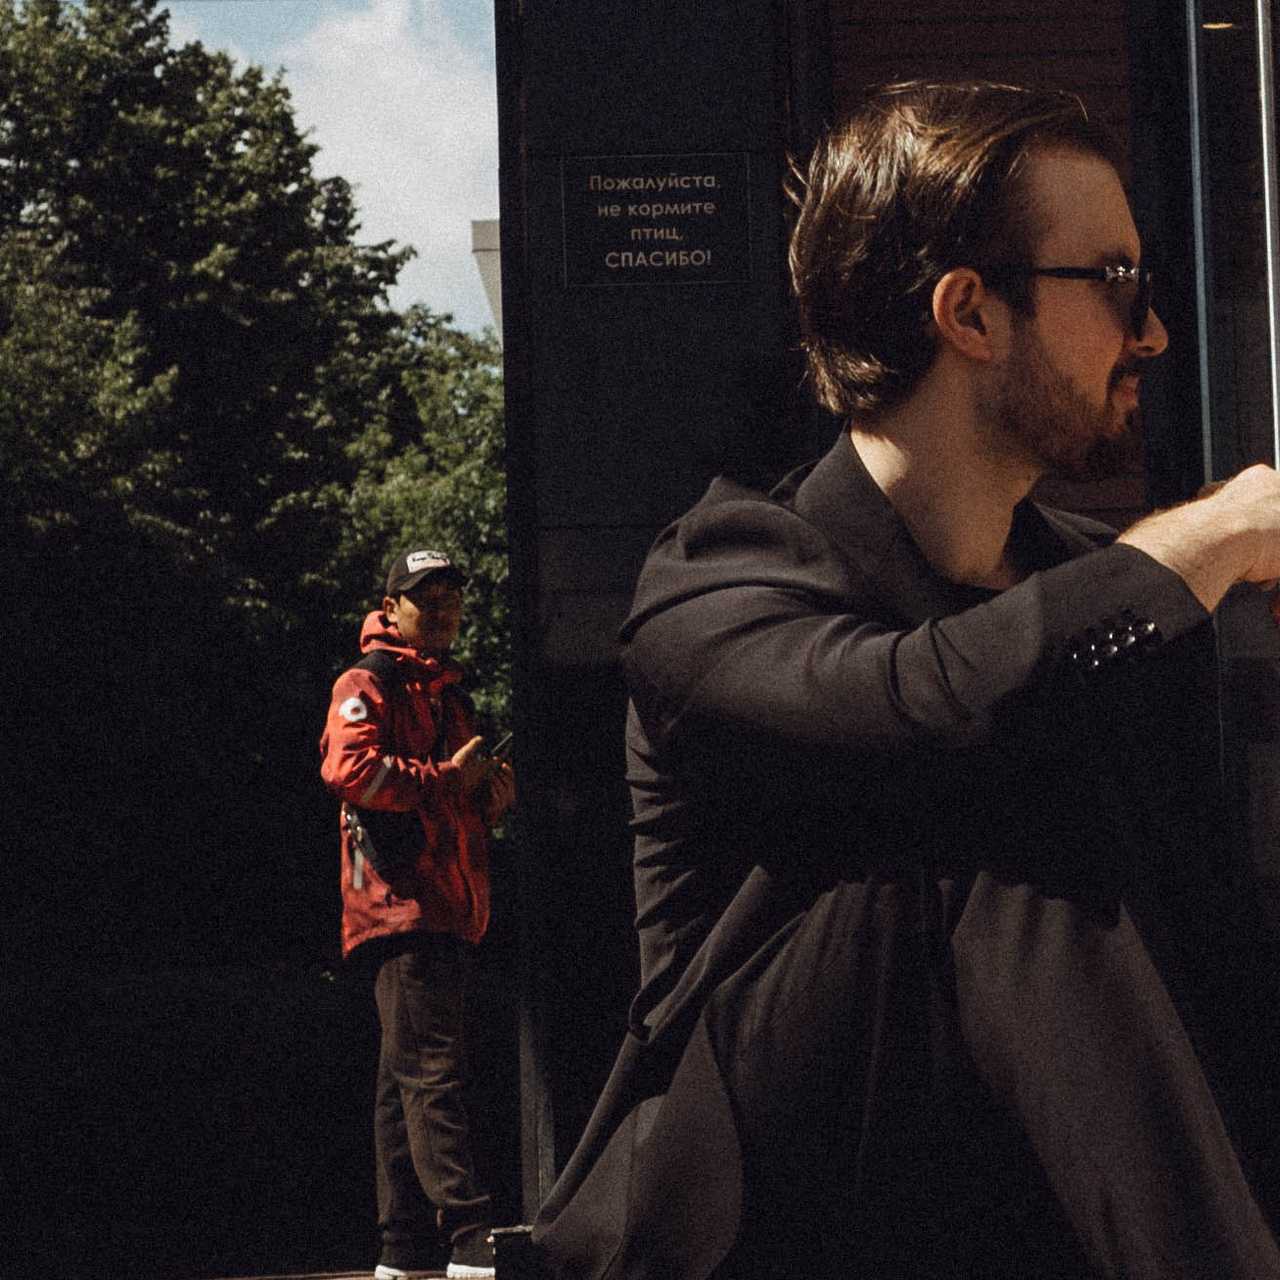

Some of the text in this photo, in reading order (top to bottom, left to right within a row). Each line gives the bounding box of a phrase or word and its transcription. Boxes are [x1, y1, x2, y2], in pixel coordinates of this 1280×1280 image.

[597, 202, 716, 219] не кормите
[605, 250, 712, 268] СПАСИБО!
